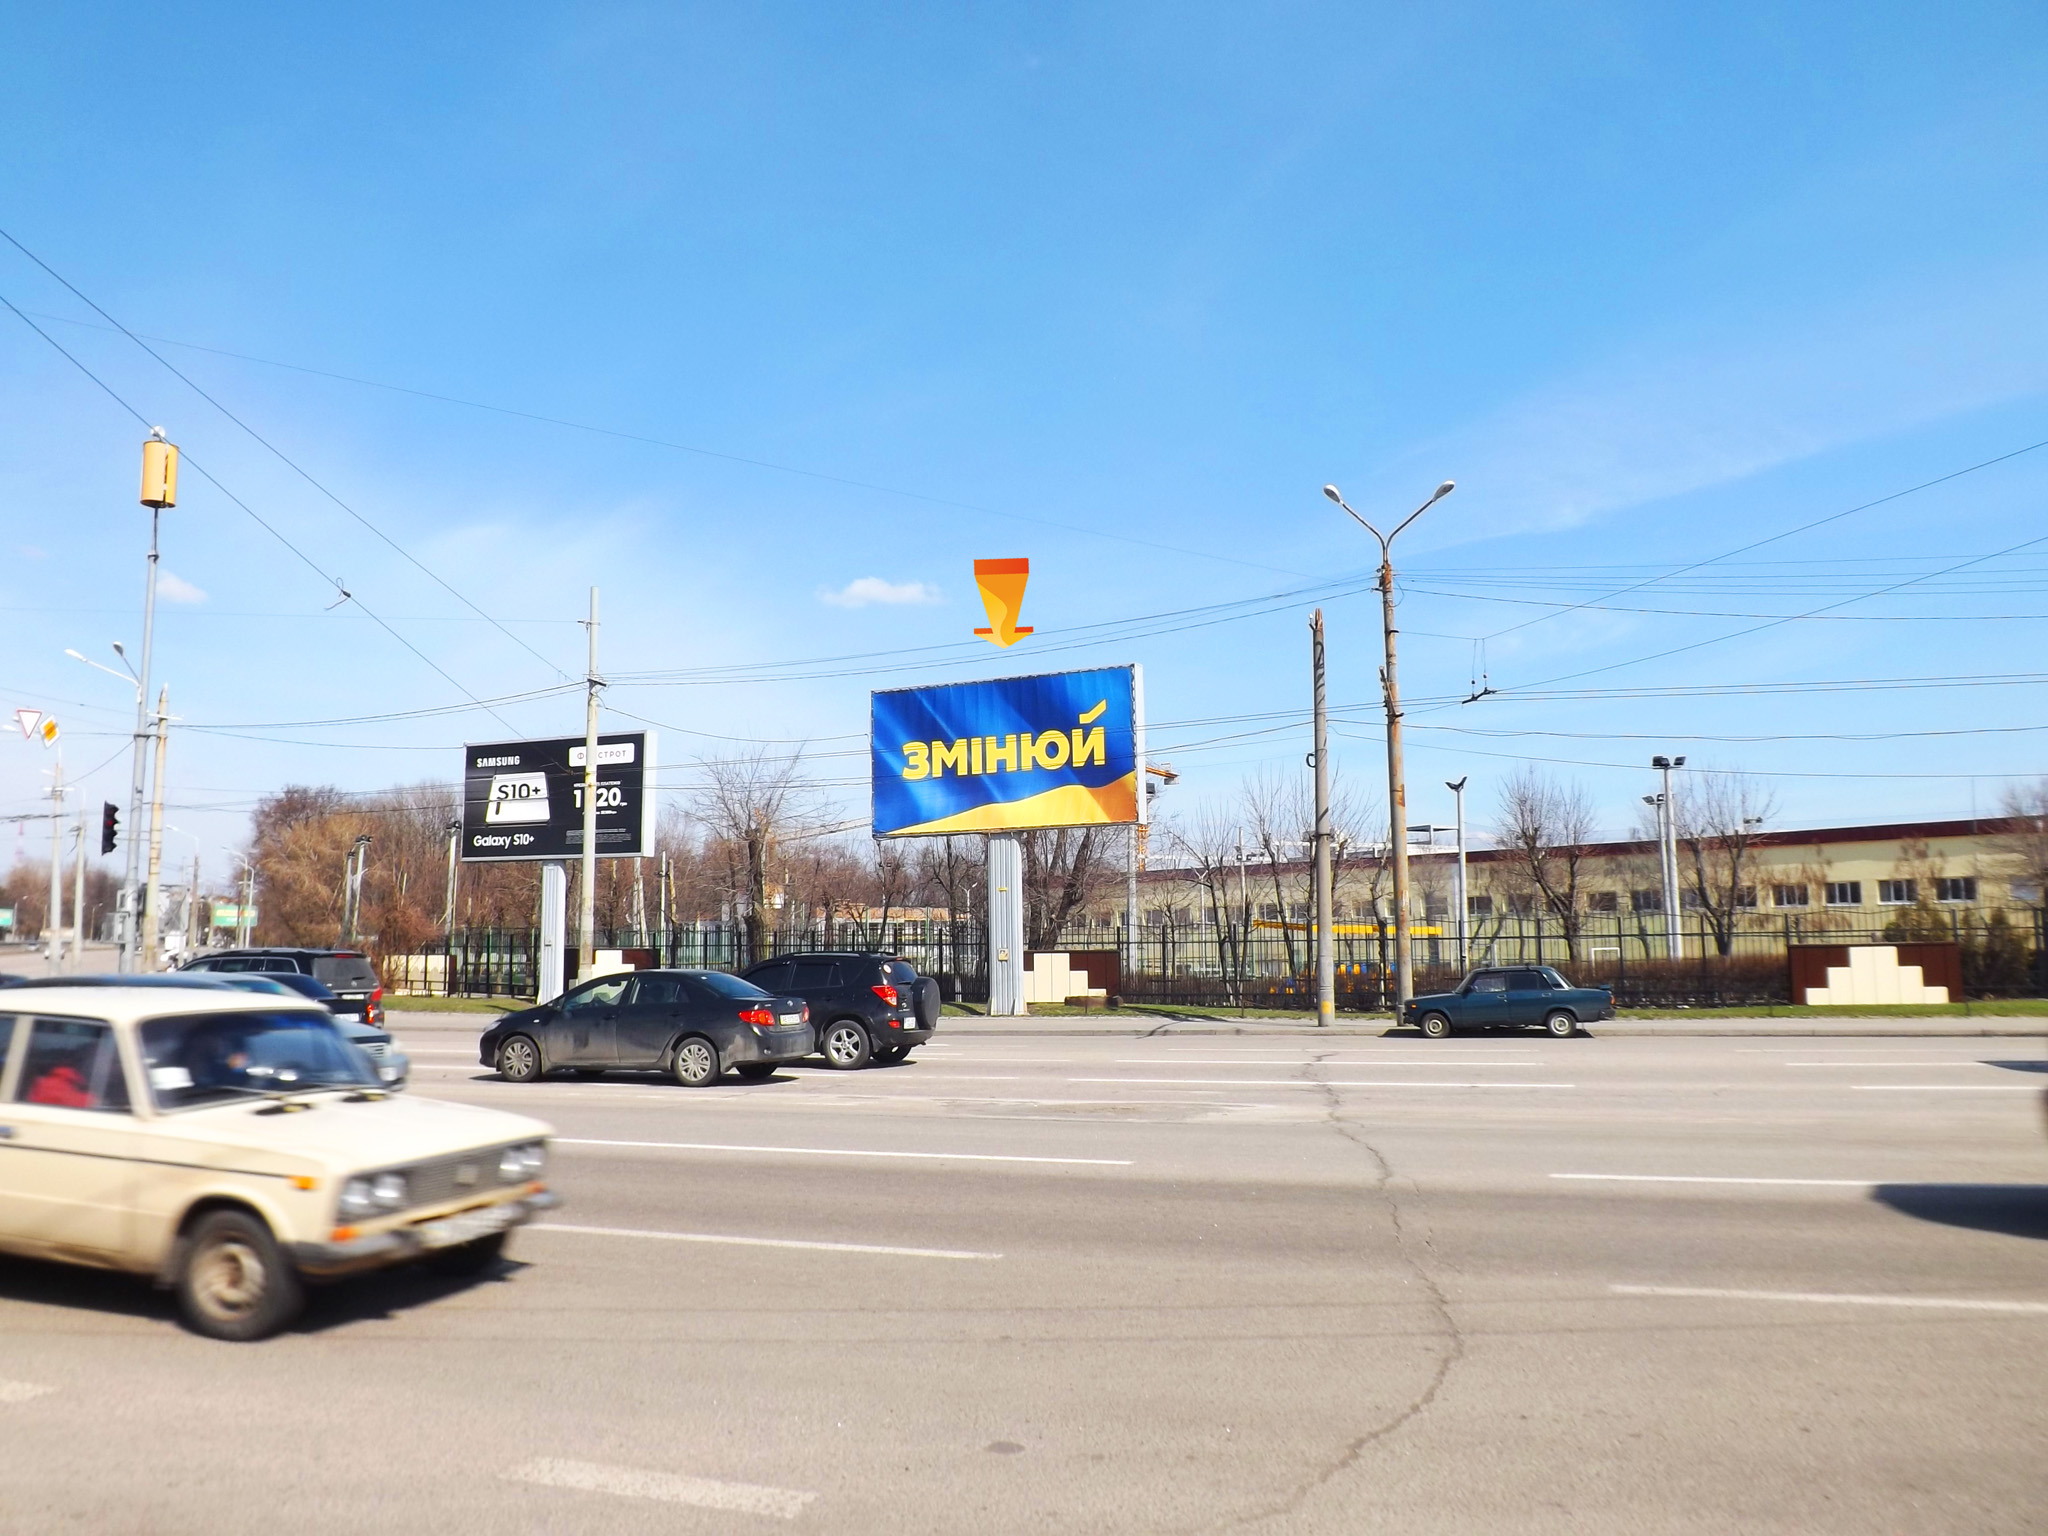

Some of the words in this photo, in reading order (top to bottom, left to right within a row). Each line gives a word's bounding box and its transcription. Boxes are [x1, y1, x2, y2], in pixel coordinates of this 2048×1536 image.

[902, 698, 1107, 780] ЗМІНЮЙ
[476, 755, 520, 768] SAMSUNG
[577, 750, 627, 760] ФСТРОТ
[497, 783, 541, 800] S10+
[573, 787, 621, 808] 120
[473, 835, 511, 849] Galaxy
[513, 833, 535, 846] S10+
